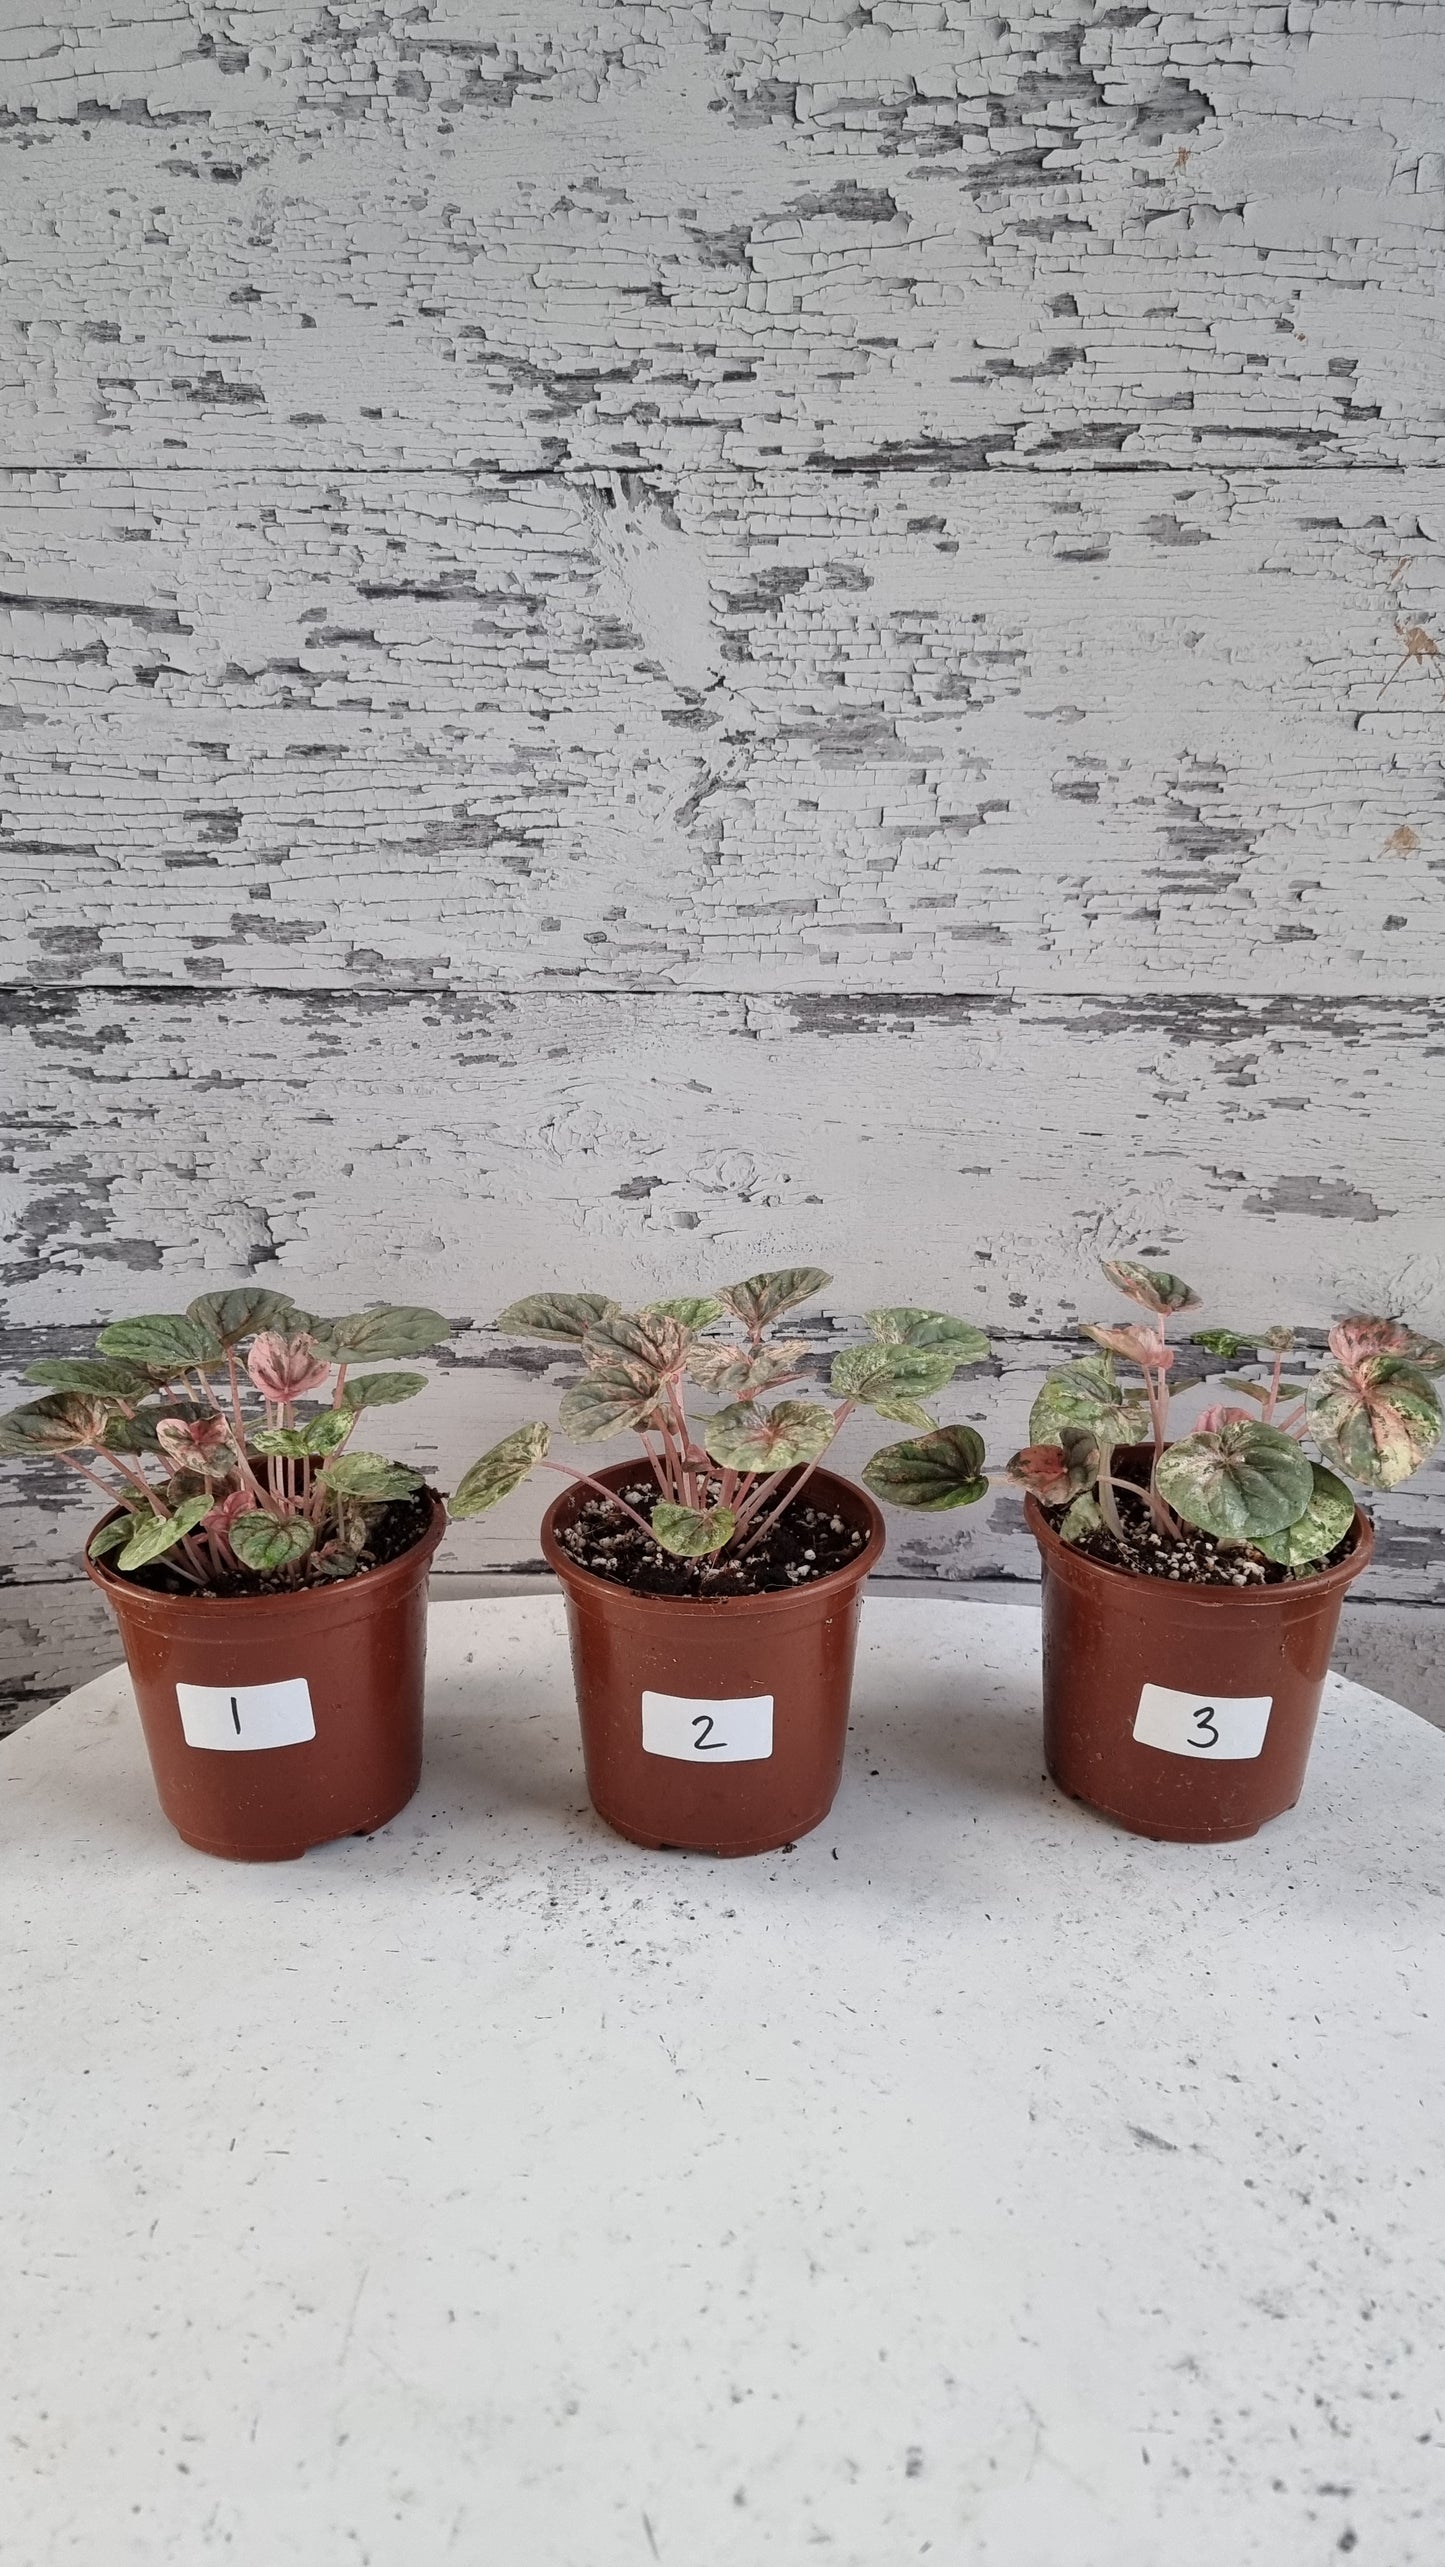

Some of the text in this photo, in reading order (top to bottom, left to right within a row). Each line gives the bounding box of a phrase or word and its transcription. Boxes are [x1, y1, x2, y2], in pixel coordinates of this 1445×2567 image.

[230, 1696, 242, 1735] 1
[691, 1715, 728, 1750] 2
[1186, 1706, 1219, 1749] 3
